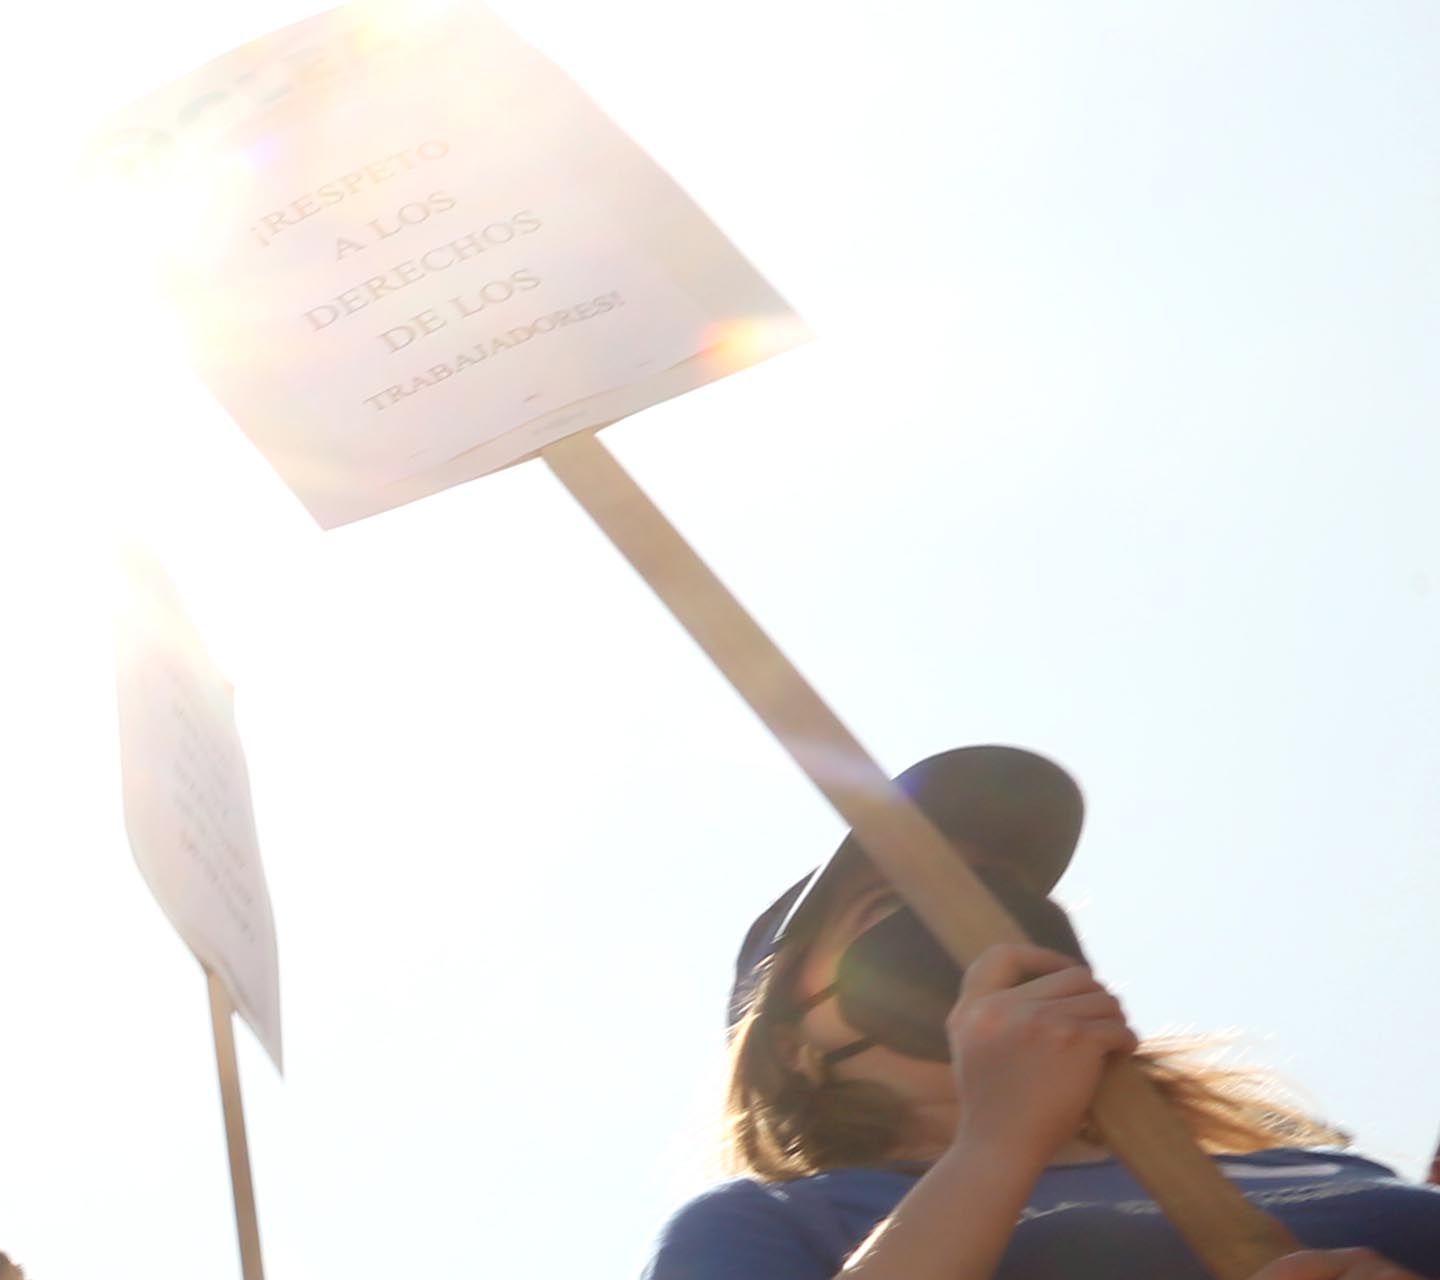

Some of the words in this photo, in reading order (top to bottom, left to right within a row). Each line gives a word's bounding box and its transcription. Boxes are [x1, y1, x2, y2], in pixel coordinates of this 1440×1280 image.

[301, 208, 545, 333] DERECHOS
[332, 236, 367, 262] A
[376, 188, 459, 243] LOS
[359, 290, 628, 412] TRABAJADORES!
[378, 306, 450, 355] DE
[451, 267, 544, 323] LOS
